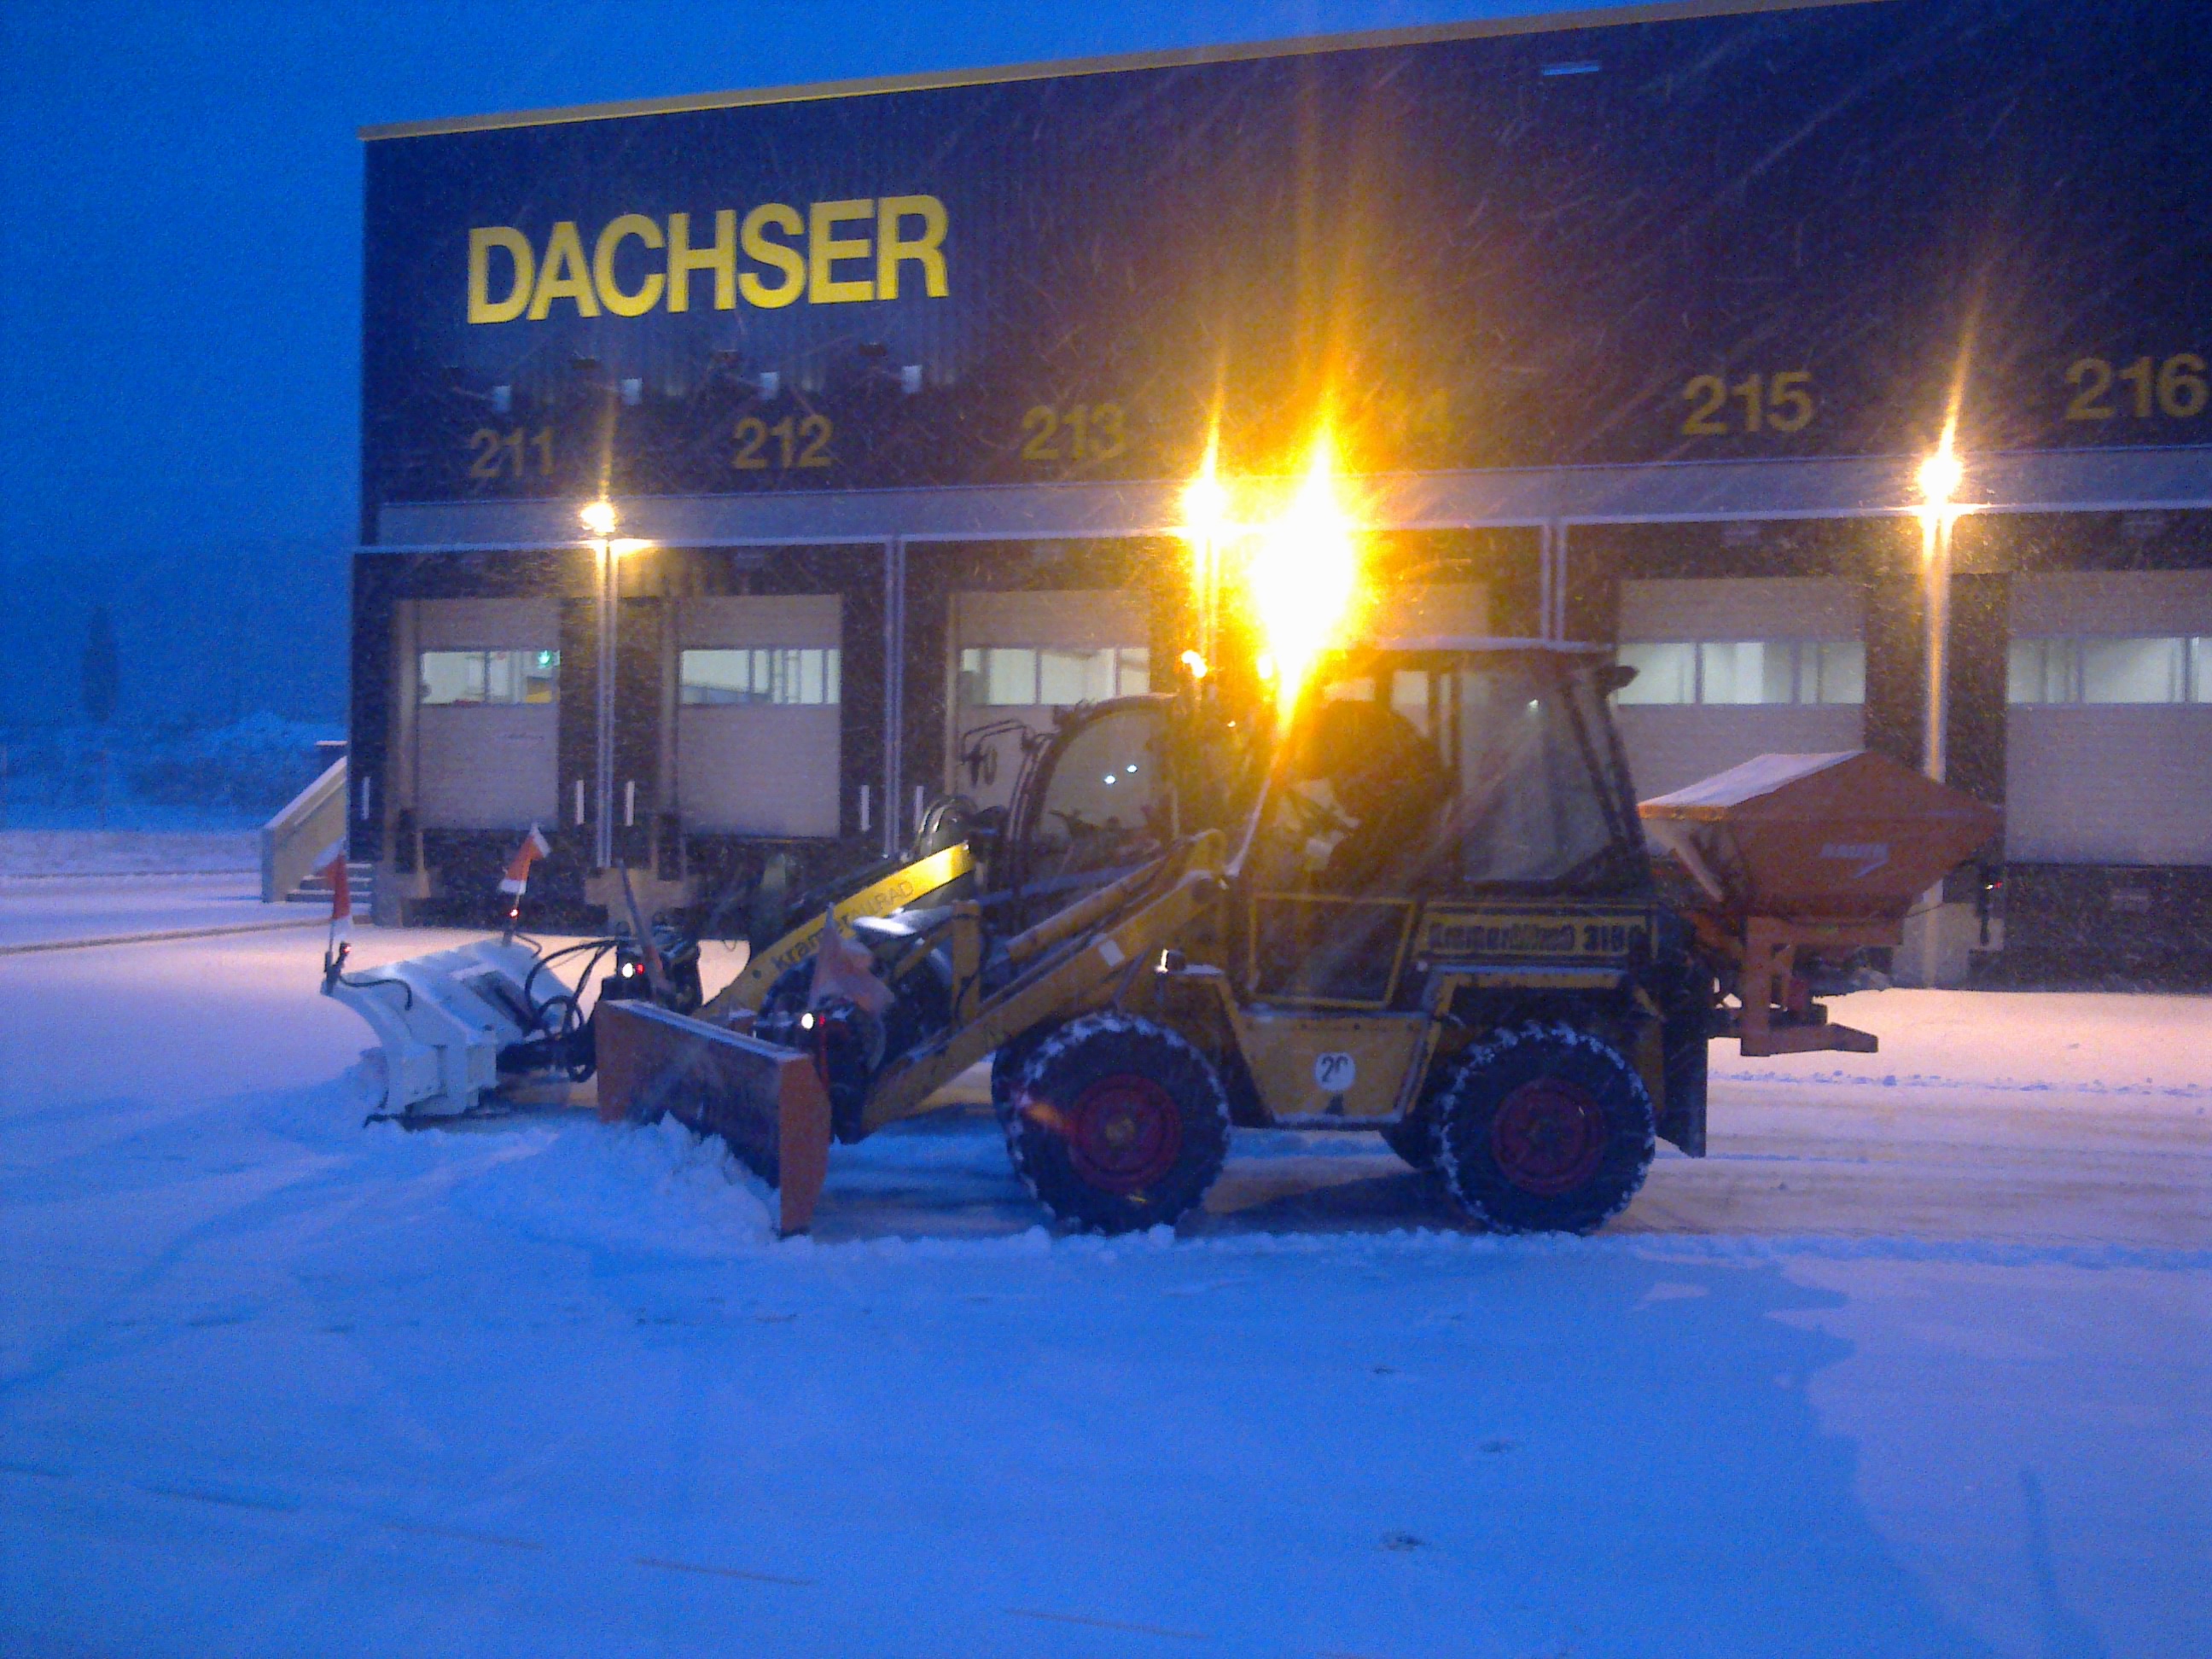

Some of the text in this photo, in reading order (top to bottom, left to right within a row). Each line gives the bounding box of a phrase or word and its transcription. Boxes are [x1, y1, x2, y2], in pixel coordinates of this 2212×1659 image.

[467, 194, 950, 324] DACHSER
[1681, 371, 1813, 434] 215
[2064, 352, 2209, 421] 216
[731, 414, 834, 469] 212
[1022, 403, 1126, 460] 213
[1350, 387, 1456, 445] 14
[469, 426, 556, 479] 211
